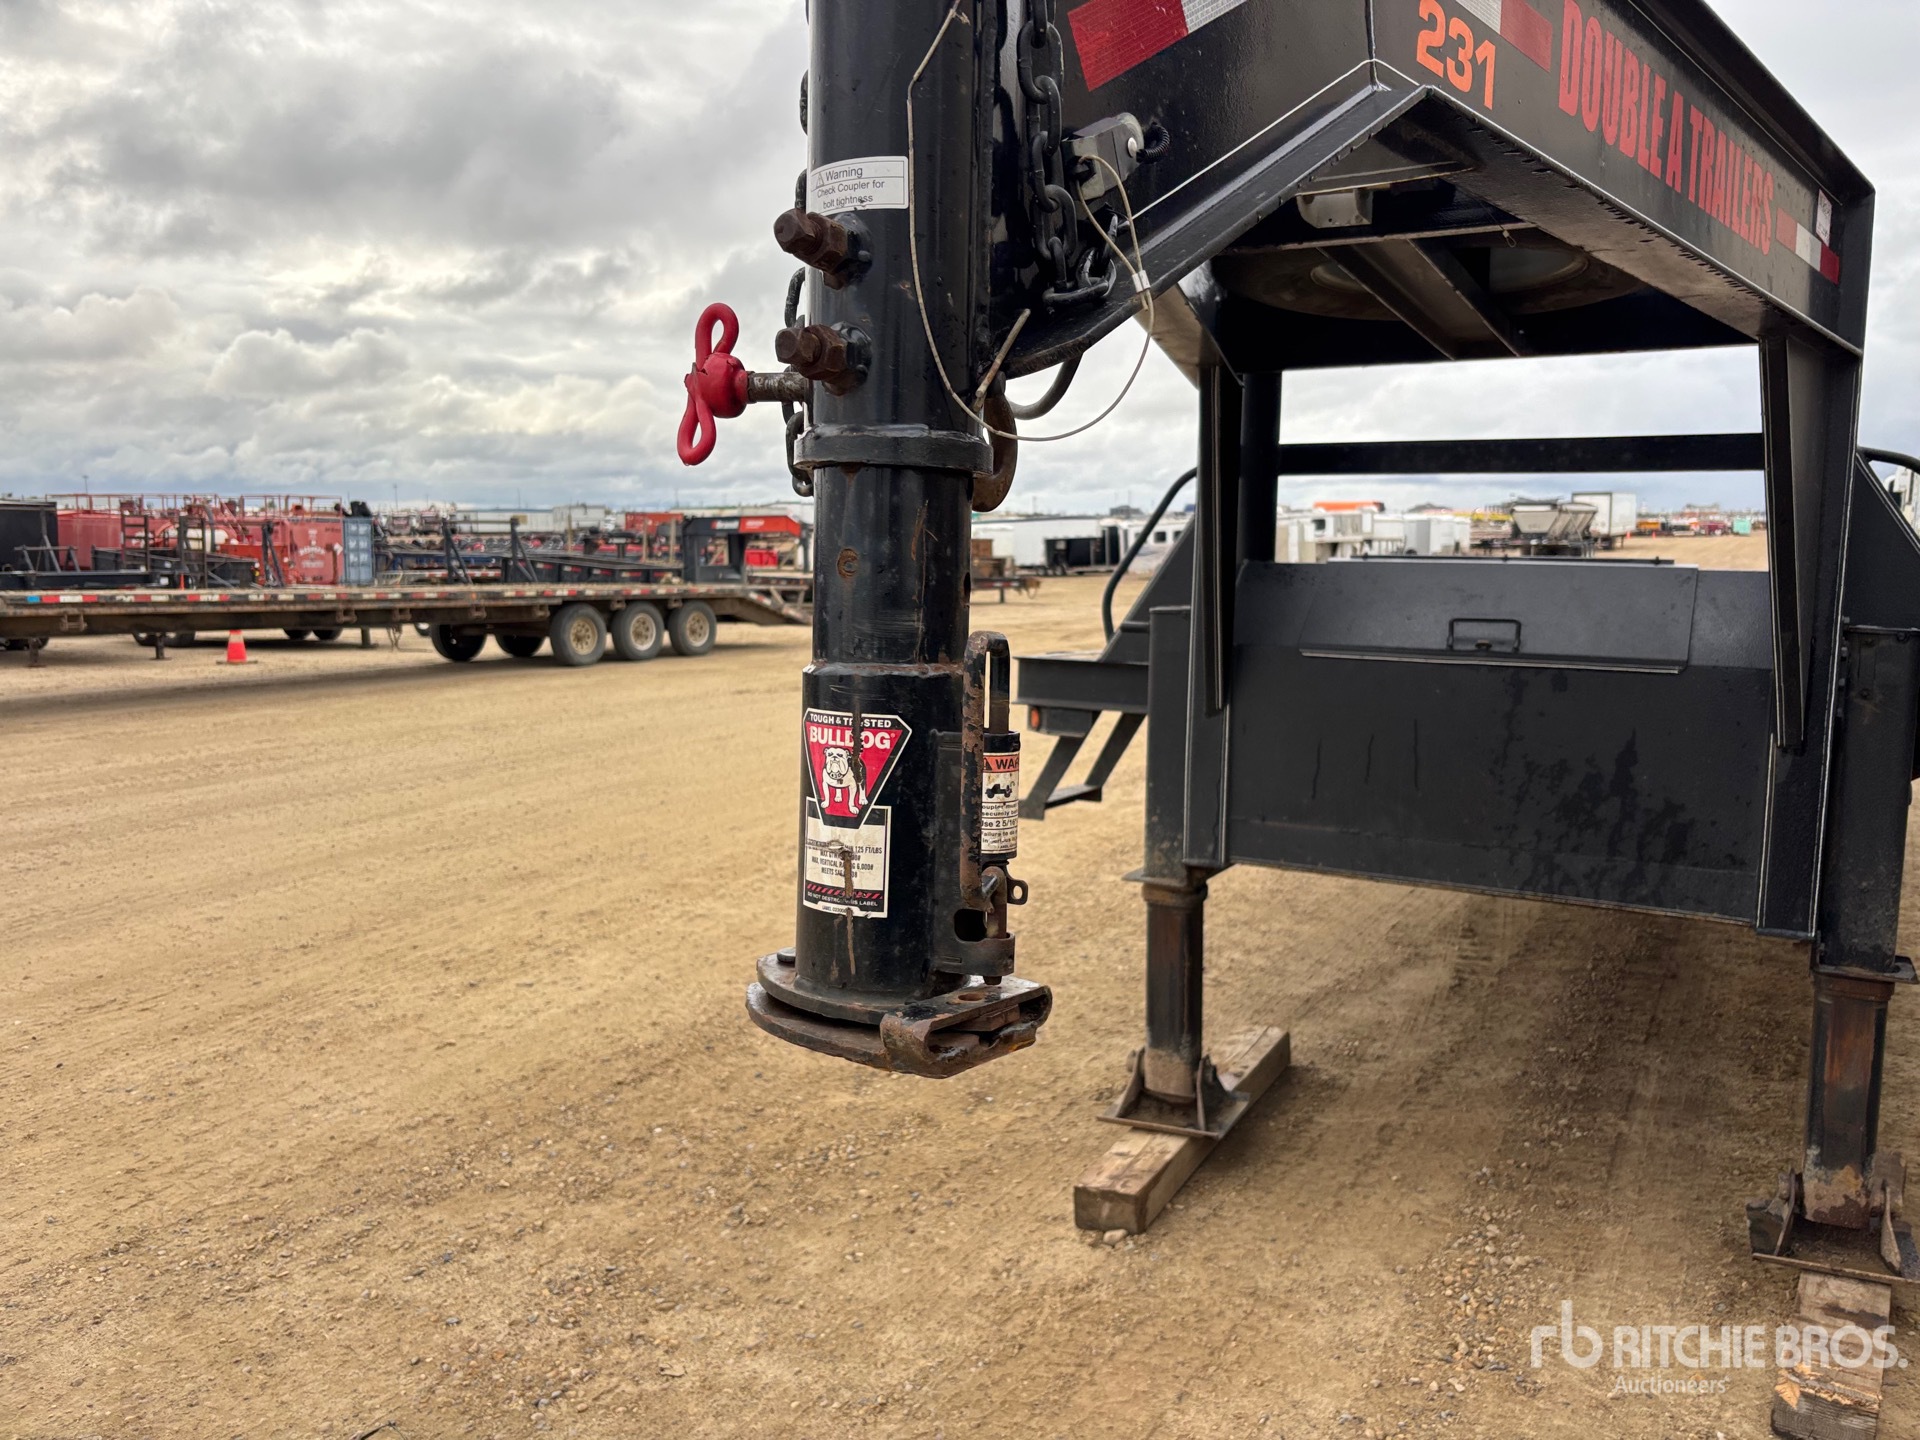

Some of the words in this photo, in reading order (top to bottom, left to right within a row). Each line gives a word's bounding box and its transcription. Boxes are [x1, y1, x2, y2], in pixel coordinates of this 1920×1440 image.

[1416, 0, 1496, 110] 231
[1558, 0, 1667, 180] DOUBLE
[1665, 90, 1683, 193] A
[1688, 104, 1774, 256] TRAILERS
[825, 167, 863, 181] Warning
[817, 185, 835, 198] Check
[837, 180, 870, 192] Coupler
[872, 179, 885, 189] for
[823, 200, 835, 209] bolt
[835, 194, 873, 207] tightness
[810, 713, 835, 724] TOUGH
[843, 717, 891, 728] TRSTED
[809, 726, 891, 749] BULLDOG
[995, 820, 1001, 828] 2
[855, 845, 864, 854] 125
[865, 846, 883, 855] FT/LBS
[821, 867, 834, 876] MEETS
